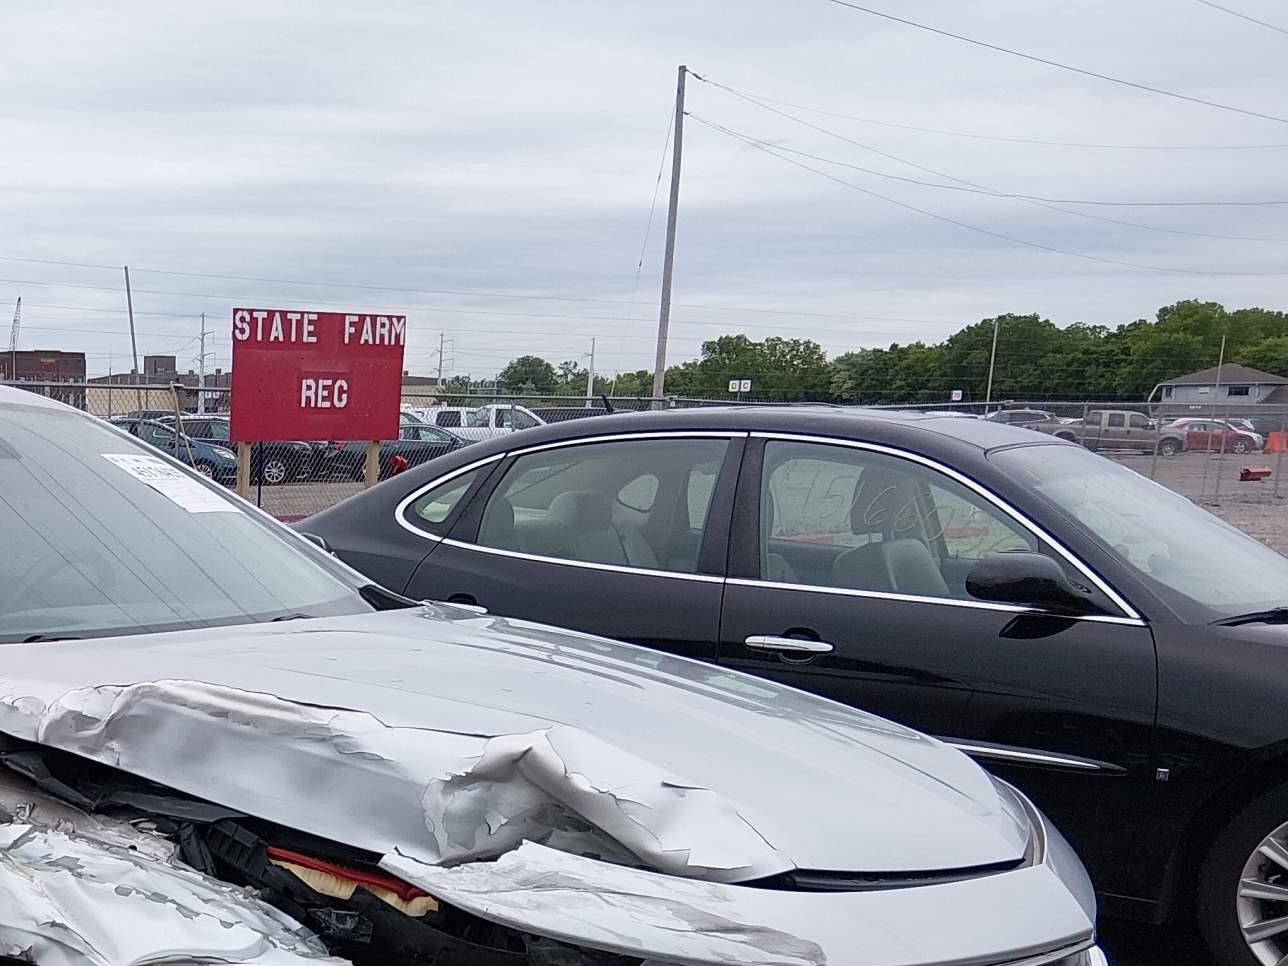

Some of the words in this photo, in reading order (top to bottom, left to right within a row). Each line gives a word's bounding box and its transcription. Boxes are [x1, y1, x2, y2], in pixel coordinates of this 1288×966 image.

[234, 310, 318, 343] STATE
[344, 315, 406, 346] FARM
[300, 379, 349, 409] REG
